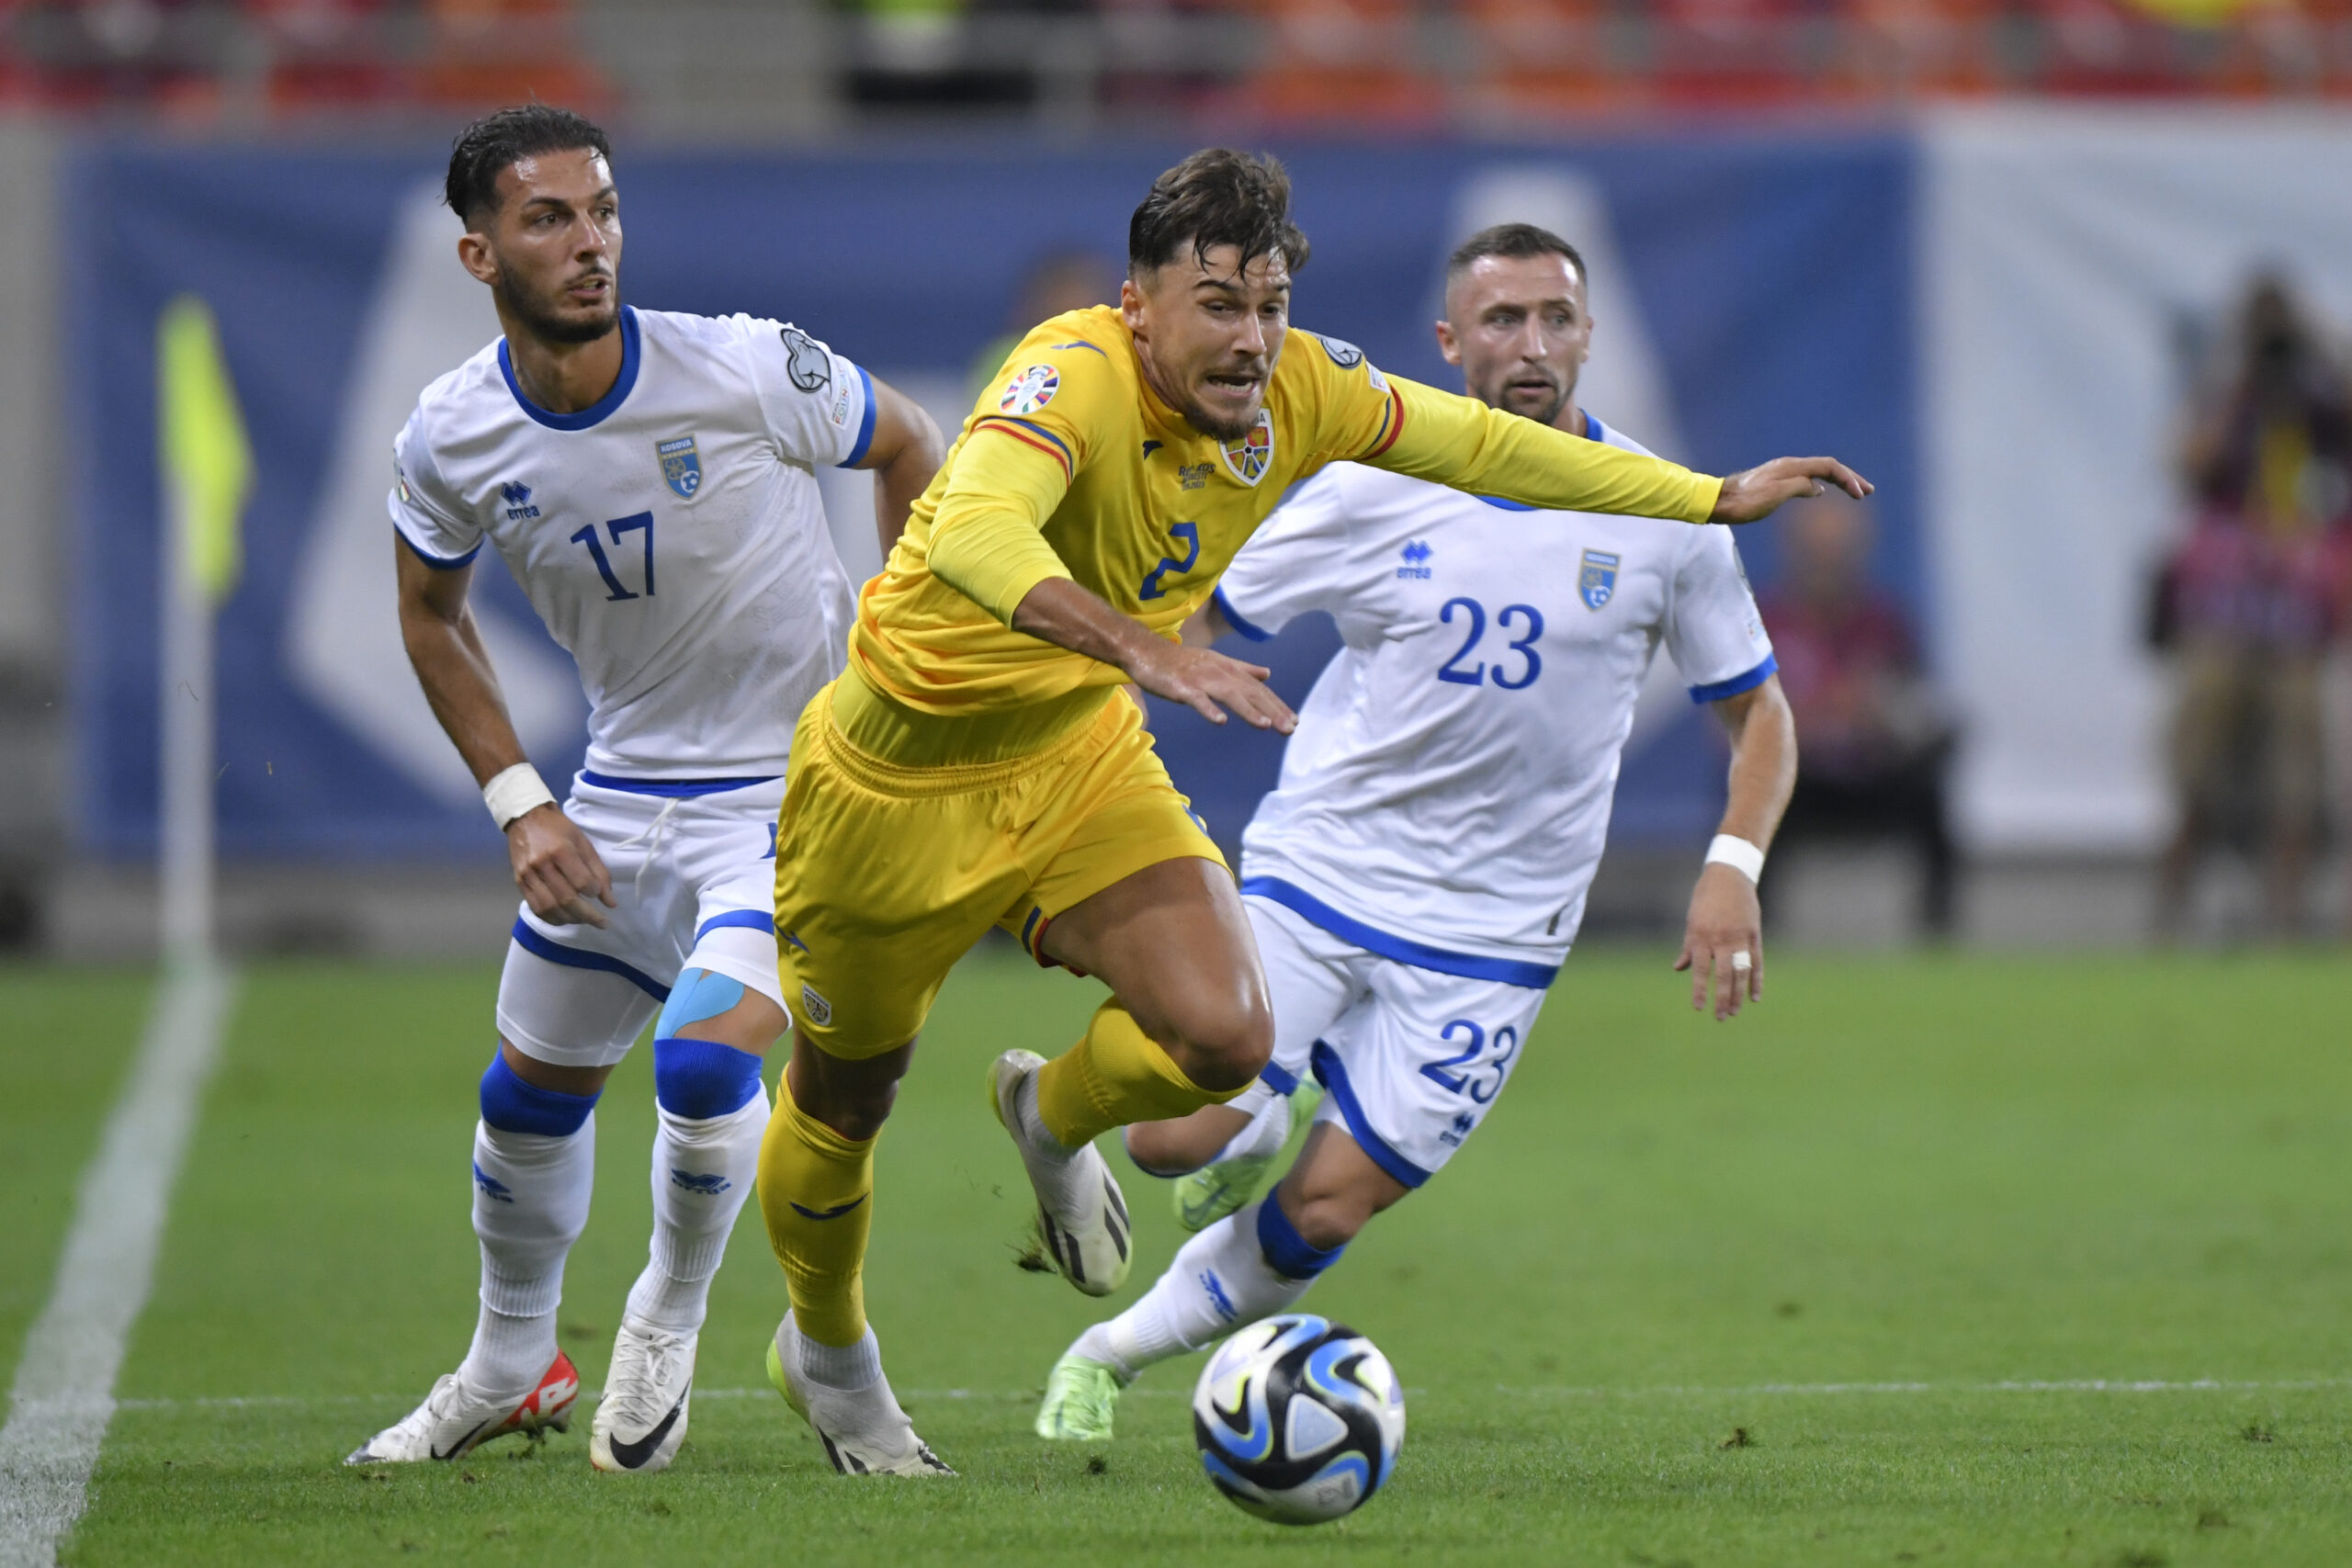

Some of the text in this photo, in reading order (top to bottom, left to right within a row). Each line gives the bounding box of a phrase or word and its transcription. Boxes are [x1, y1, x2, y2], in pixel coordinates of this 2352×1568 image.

[570, 510, 655, 601] 17
[1139, 521, 1200, 601] 2
[1437, 596, 1544, 690] 23
[1419, 1019, 1517, 1104] 23
